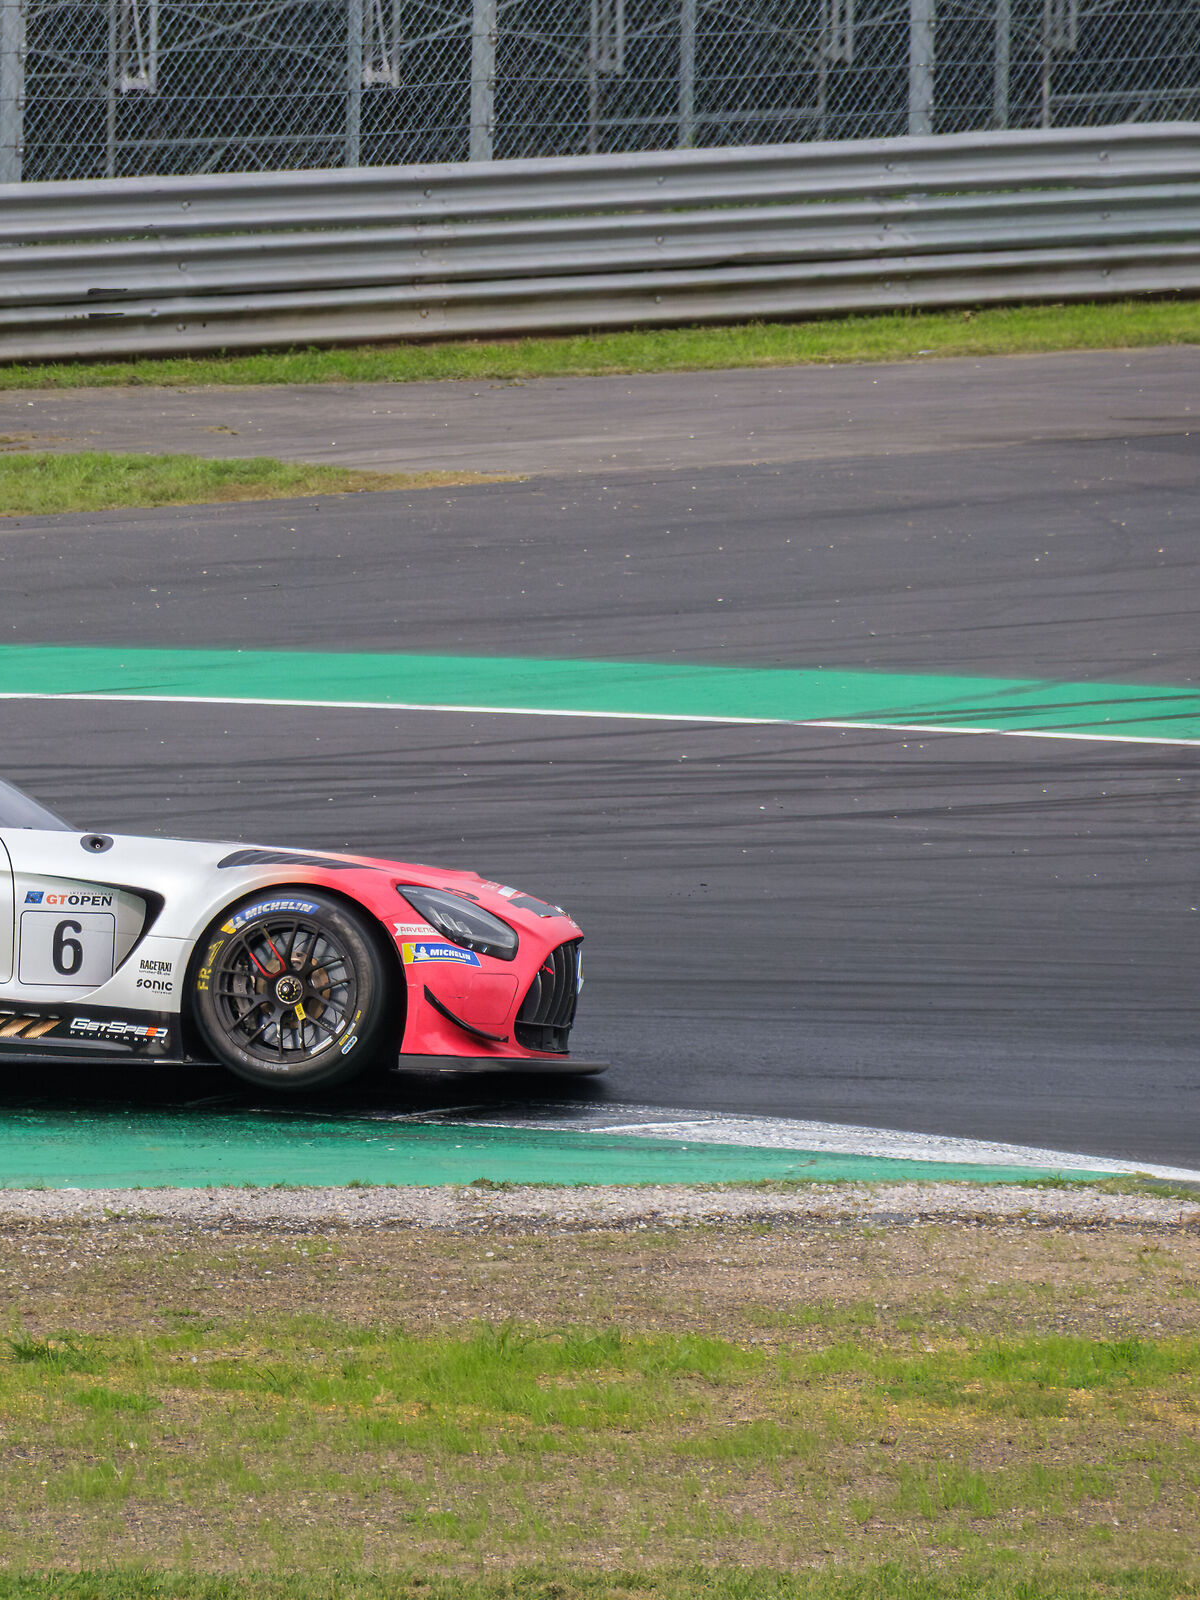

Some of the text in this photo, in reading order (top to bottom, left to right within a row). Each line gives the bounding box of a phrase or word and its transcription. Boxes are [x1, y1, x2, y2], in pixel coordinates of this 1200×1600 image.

[245, 901, 313, 920] MICHELIN
[53, 919, 83, 976] 6
[430, 949, 471, 960] MICHELIN
[140, 959, 172, 973] RACETAXI
[197, 967, 212, 990] FR
